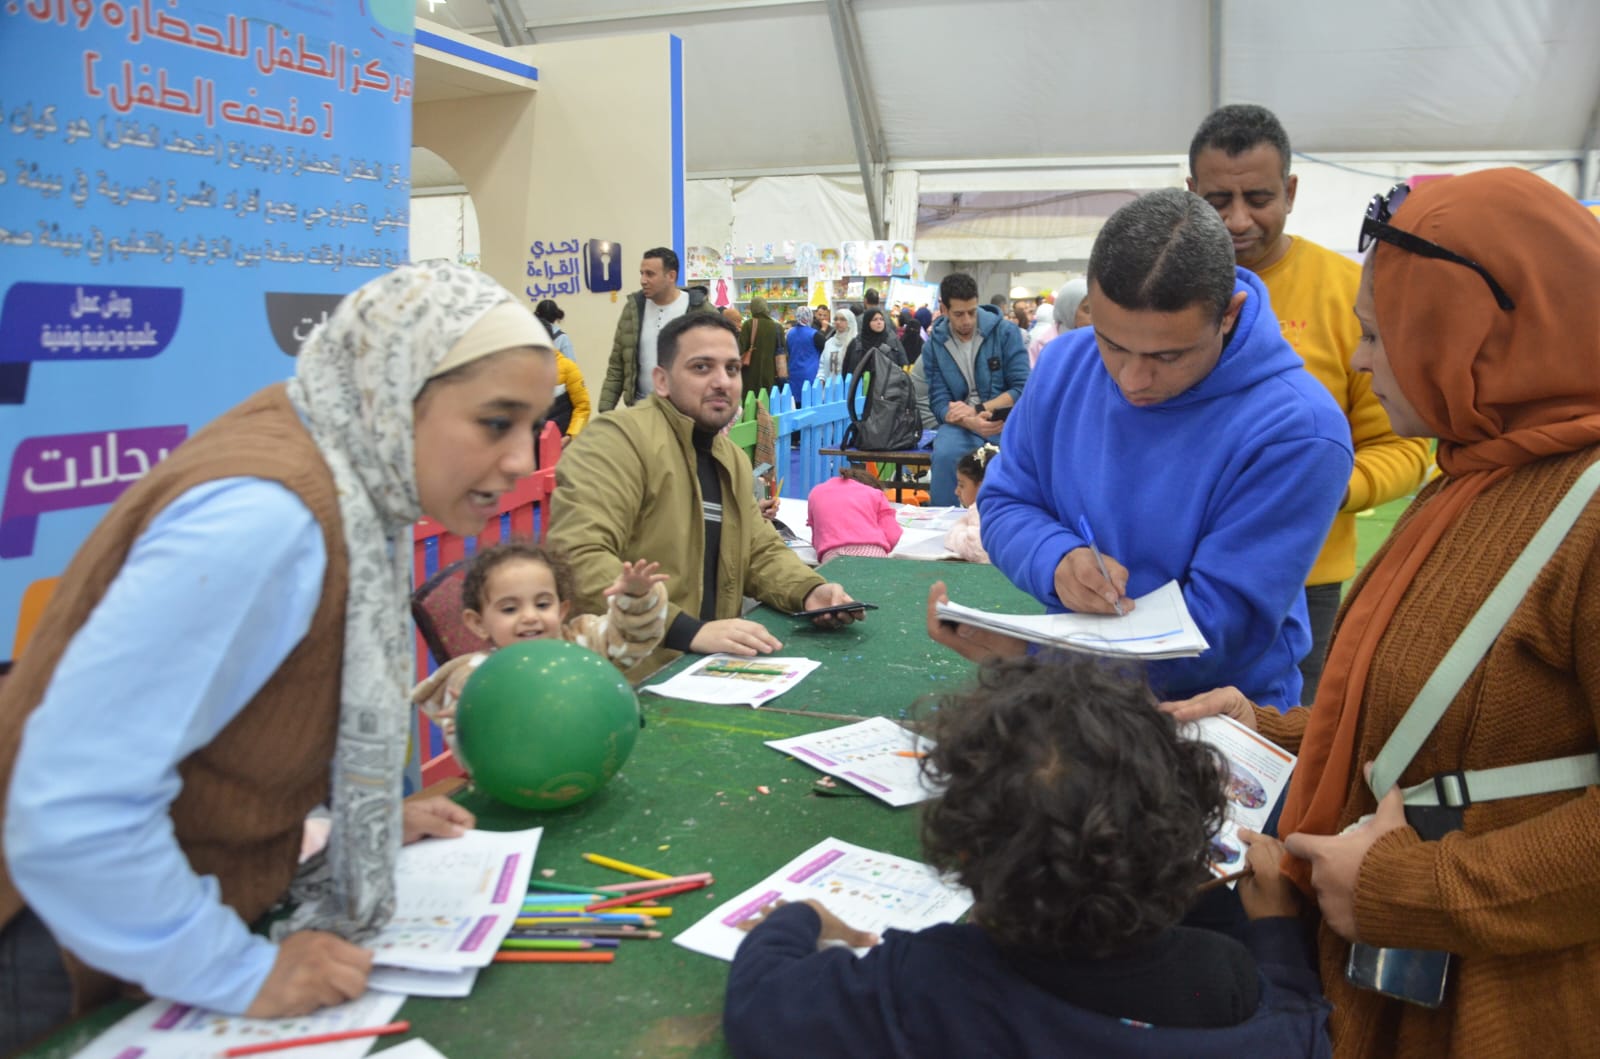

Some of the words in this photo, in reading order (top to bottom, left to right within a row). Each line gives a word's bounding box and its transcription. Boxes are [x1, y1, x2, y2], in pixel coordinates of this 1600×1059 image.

[256, 24, 346, 91] الطفل
[63, 113, 92, 144] هو
[71, 167, 89, 209] في
[86, 225, 104, 266] في
[530, 239, 580, 259] تحدي
[526, 257, 580, 280] القراءة
[70, 286, 101, 319] عمل
[525, 275, 581, 303] العربي
[100, 290, 133, 319] ورش
[125, 321, 159, 351] علمية
